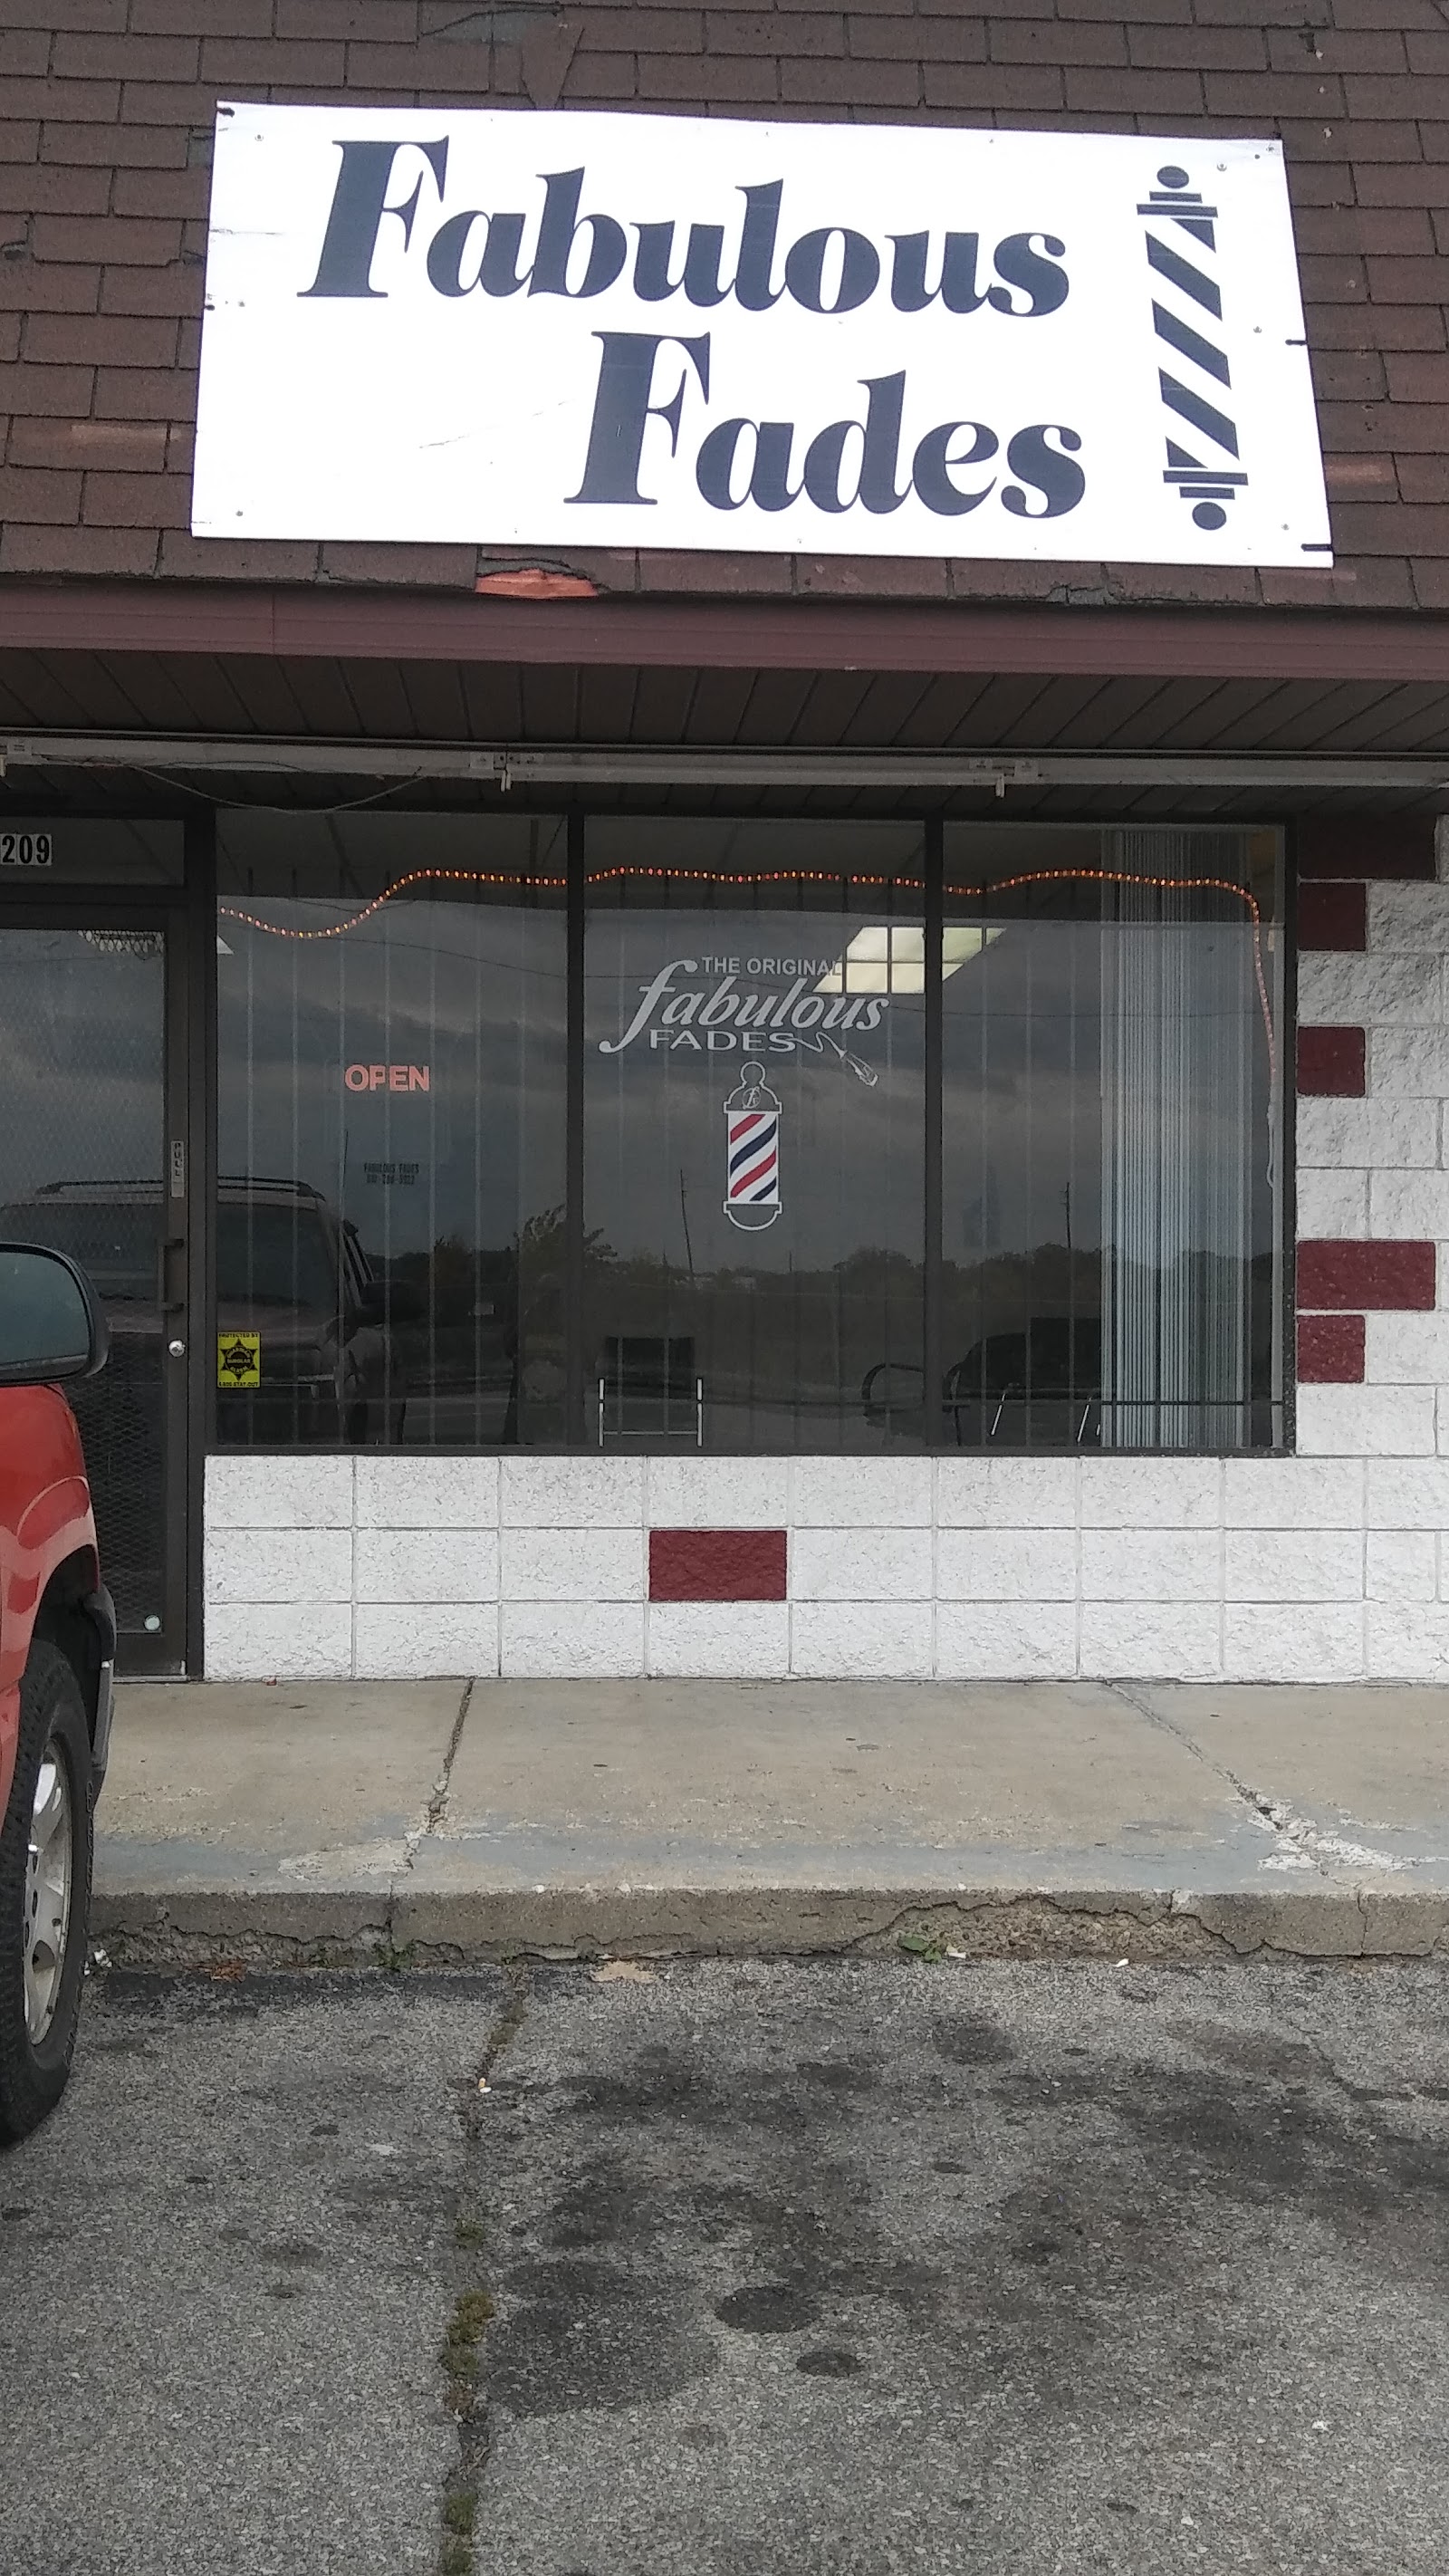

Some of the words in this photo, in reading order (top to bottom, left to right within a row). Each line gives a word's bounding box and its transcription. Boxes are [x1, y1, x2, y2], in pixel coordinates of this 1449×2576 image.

[297, 135, 1071, 317] Fabulous
[563, 331, 1087, 519] Fades
[1, 835, 50, 864] 209
[702, 956, 741, 975] THE
[746, 957, 842, 977] ORIGINAL
[598, 959, 890, 1054] fabulous
[648, 1029, 798, 1053] FADES
[344, 1063, 430, 1092] OPEN
[173, 1141, 182, 1177] PULL
